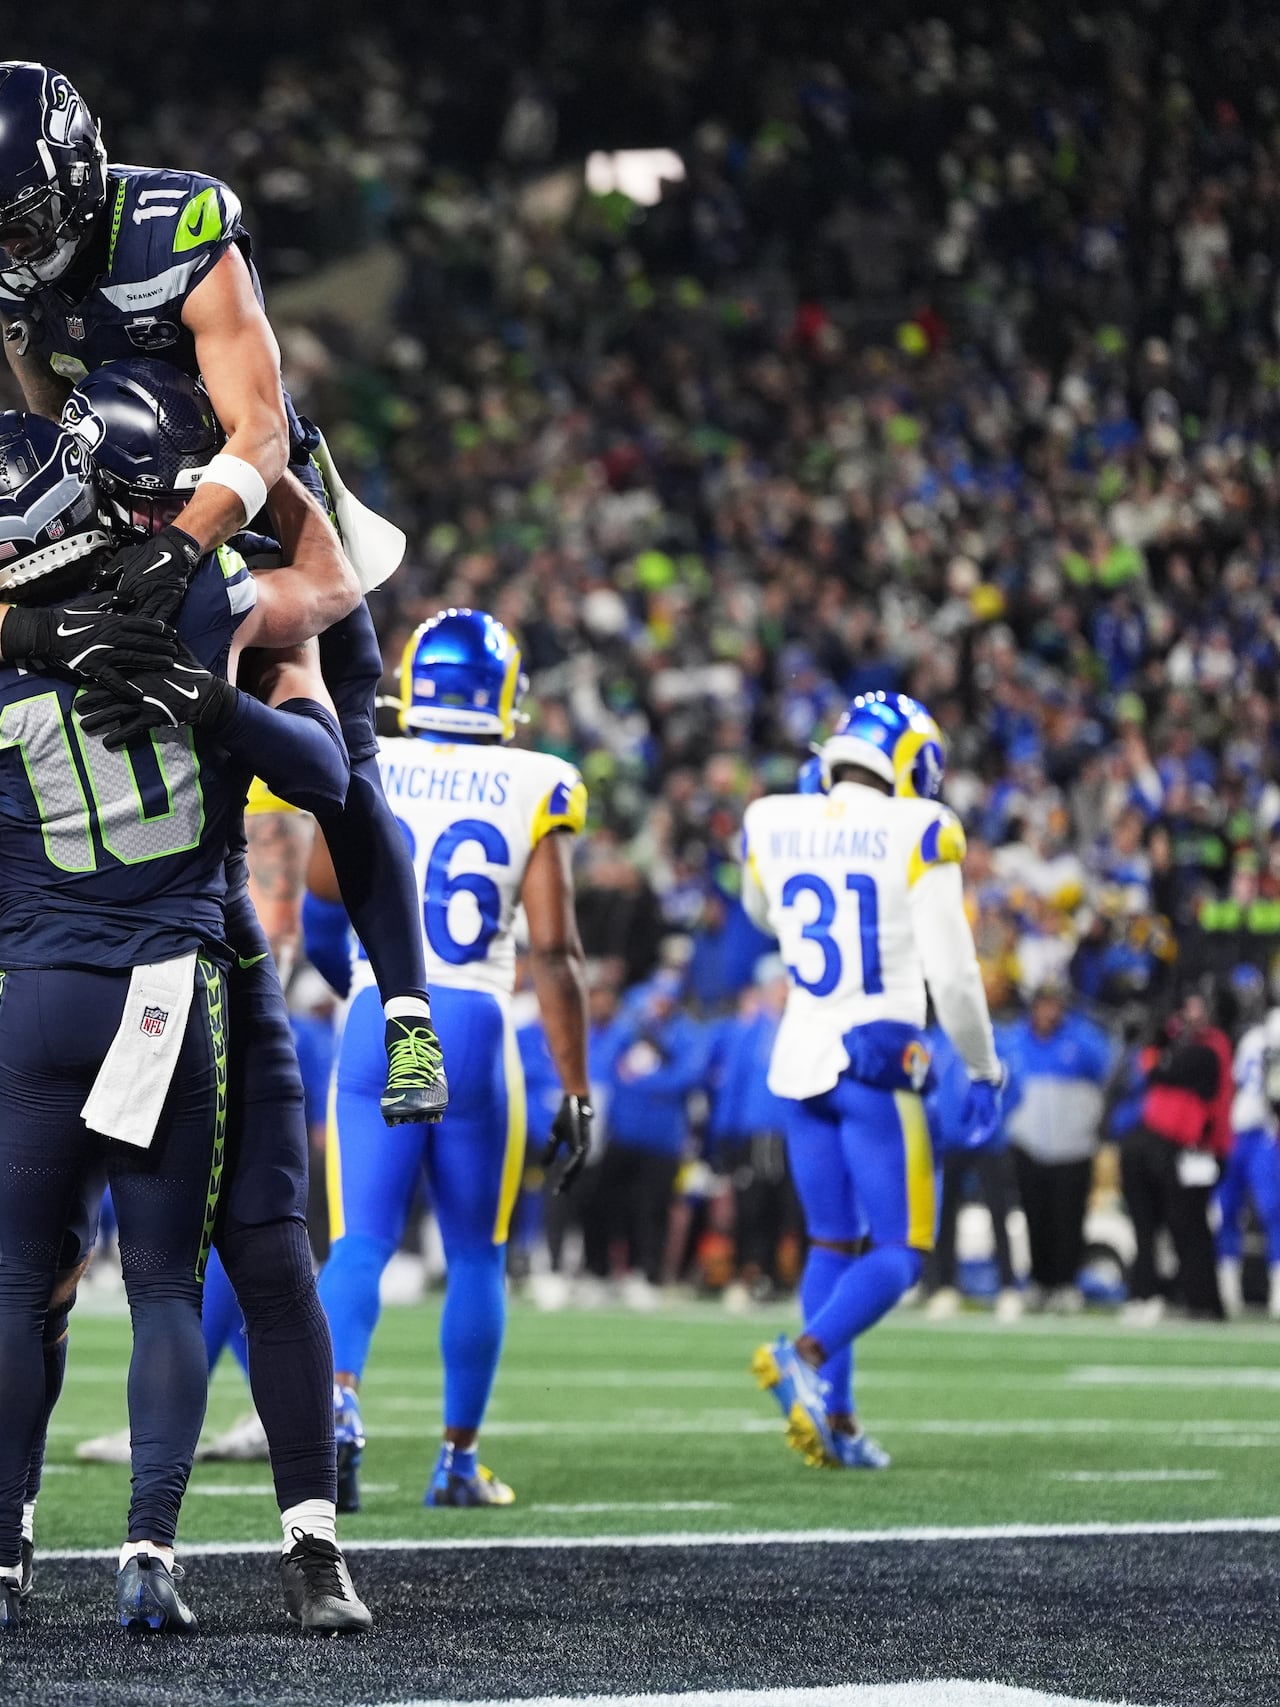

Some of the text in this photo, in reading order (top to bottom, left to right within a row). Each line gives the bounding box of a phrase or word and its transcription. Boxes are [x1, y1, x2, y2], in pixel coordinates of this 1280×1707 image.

[132, 189, 190, 225] 11
[50, 527, 64, 537] NFL
[10, 540, 78, 574] SEATTLE
[380, 763, 510, 807] NCHENS
[769, 828, 889, 861] WILLIAMS
[782, 872, 886, 998] 31
[143, 1017, 162, 1035] NFL
